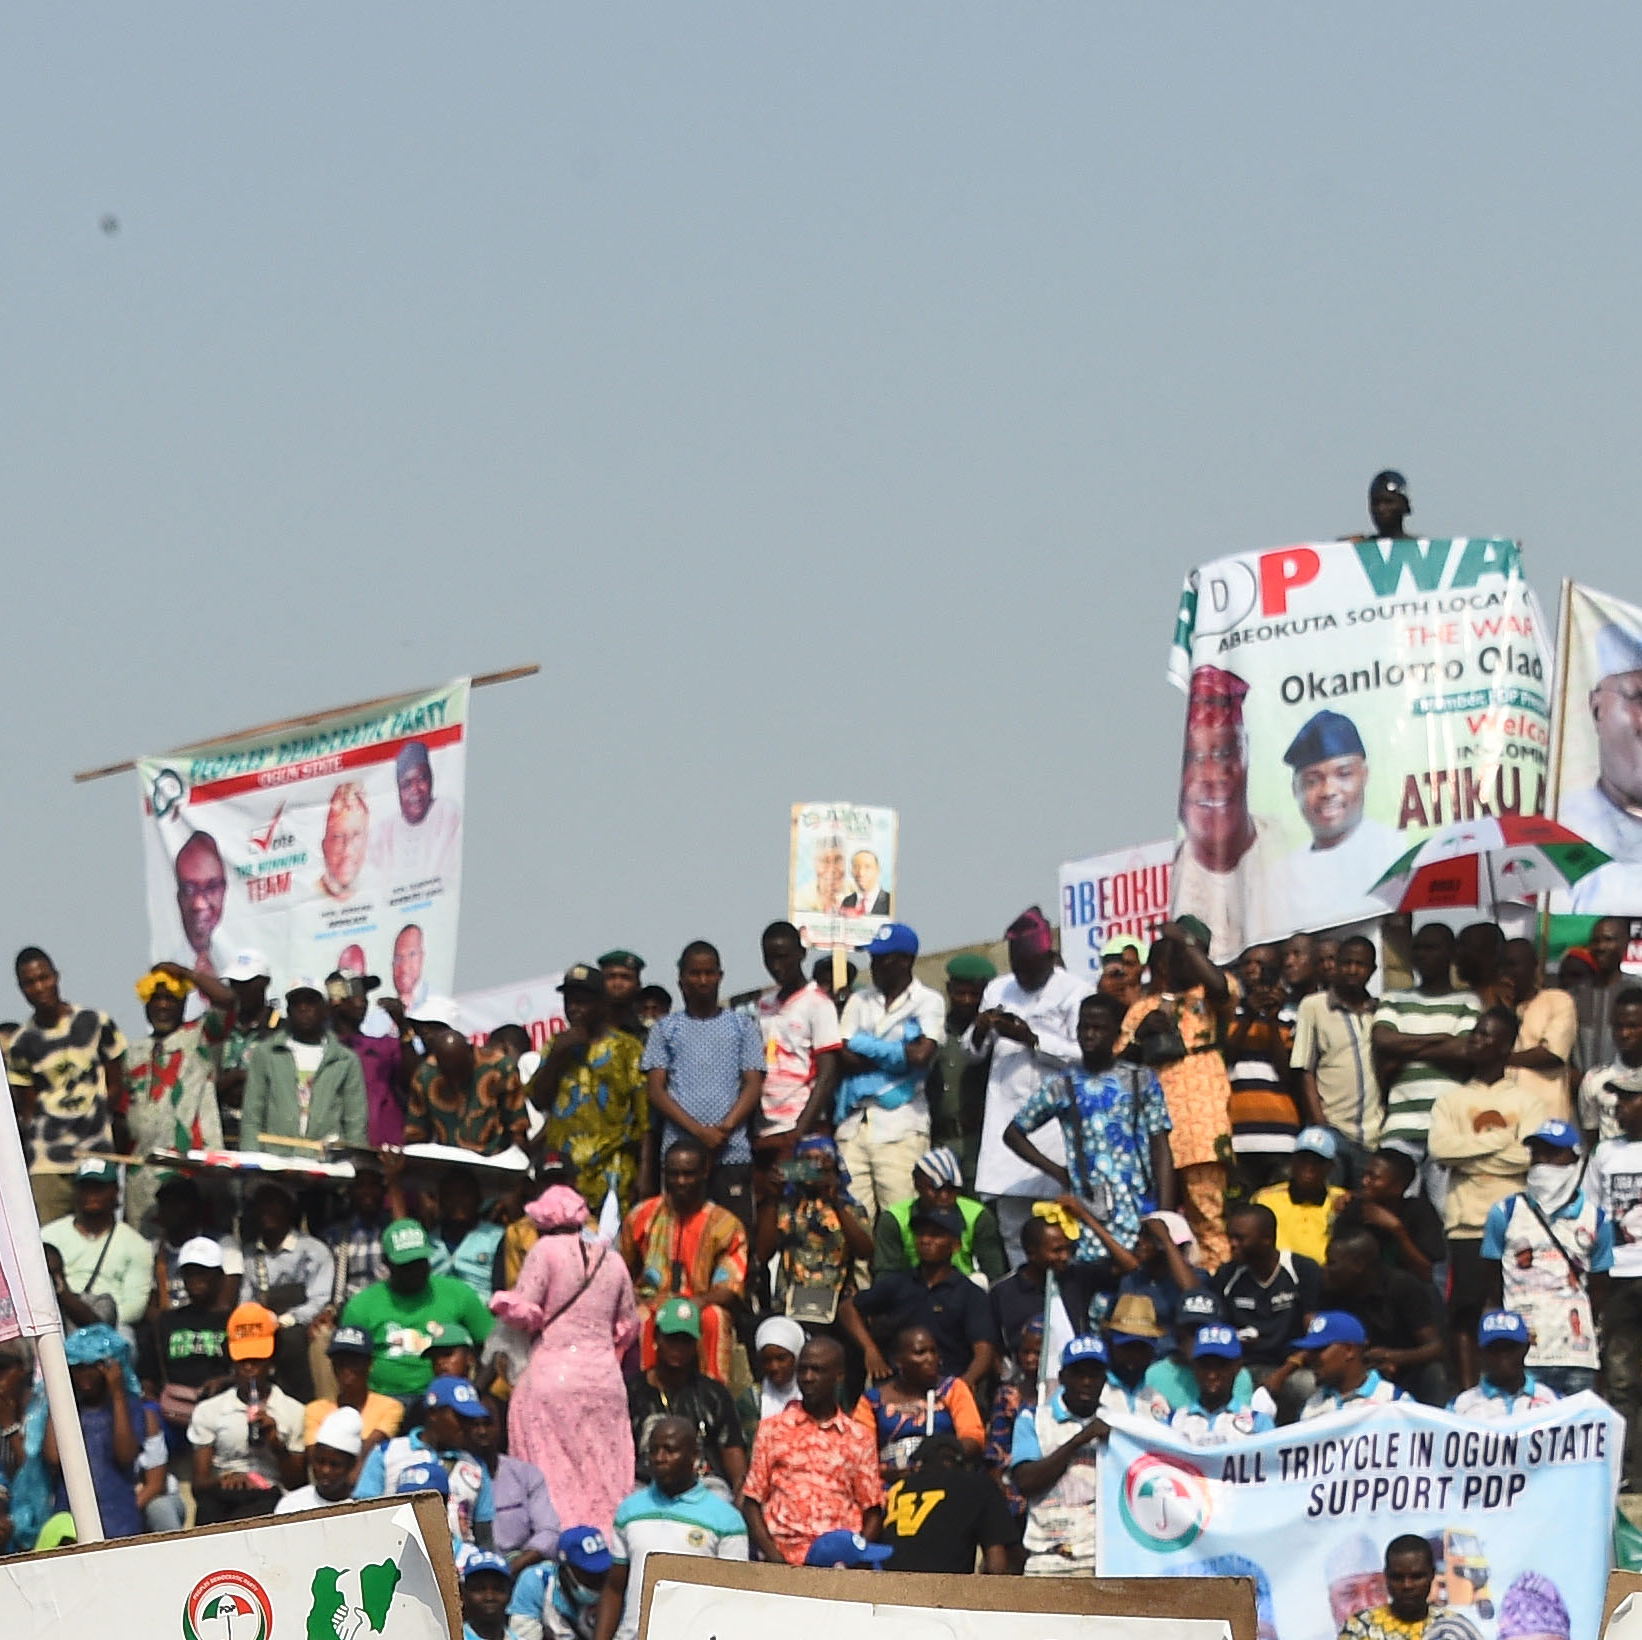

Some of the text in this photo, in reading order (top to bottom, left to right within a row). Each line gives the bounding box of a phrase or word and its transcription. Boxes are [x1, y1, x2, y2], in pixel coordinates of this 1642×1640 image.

[1218, 614, 1338, 654] ABEOKUTA
[1346, 601, 1429, 625] SOUTH
[1405, 622, 1457, 648] THE
[1280, 659, 1464, 706] Okanlomo
[391, 698, 449, 729] PARTY
[1398, 766, 1520, 830] ATIKU
[246, 872, 292, 903] TEAM
[1222, 1420, 1607, 1487] ALL TRICYCLE IN OGUN STATE
[1307, 1472, 1526, 1519] SUPPORT PDP
[218, 1602, 238, 1616] PDP
